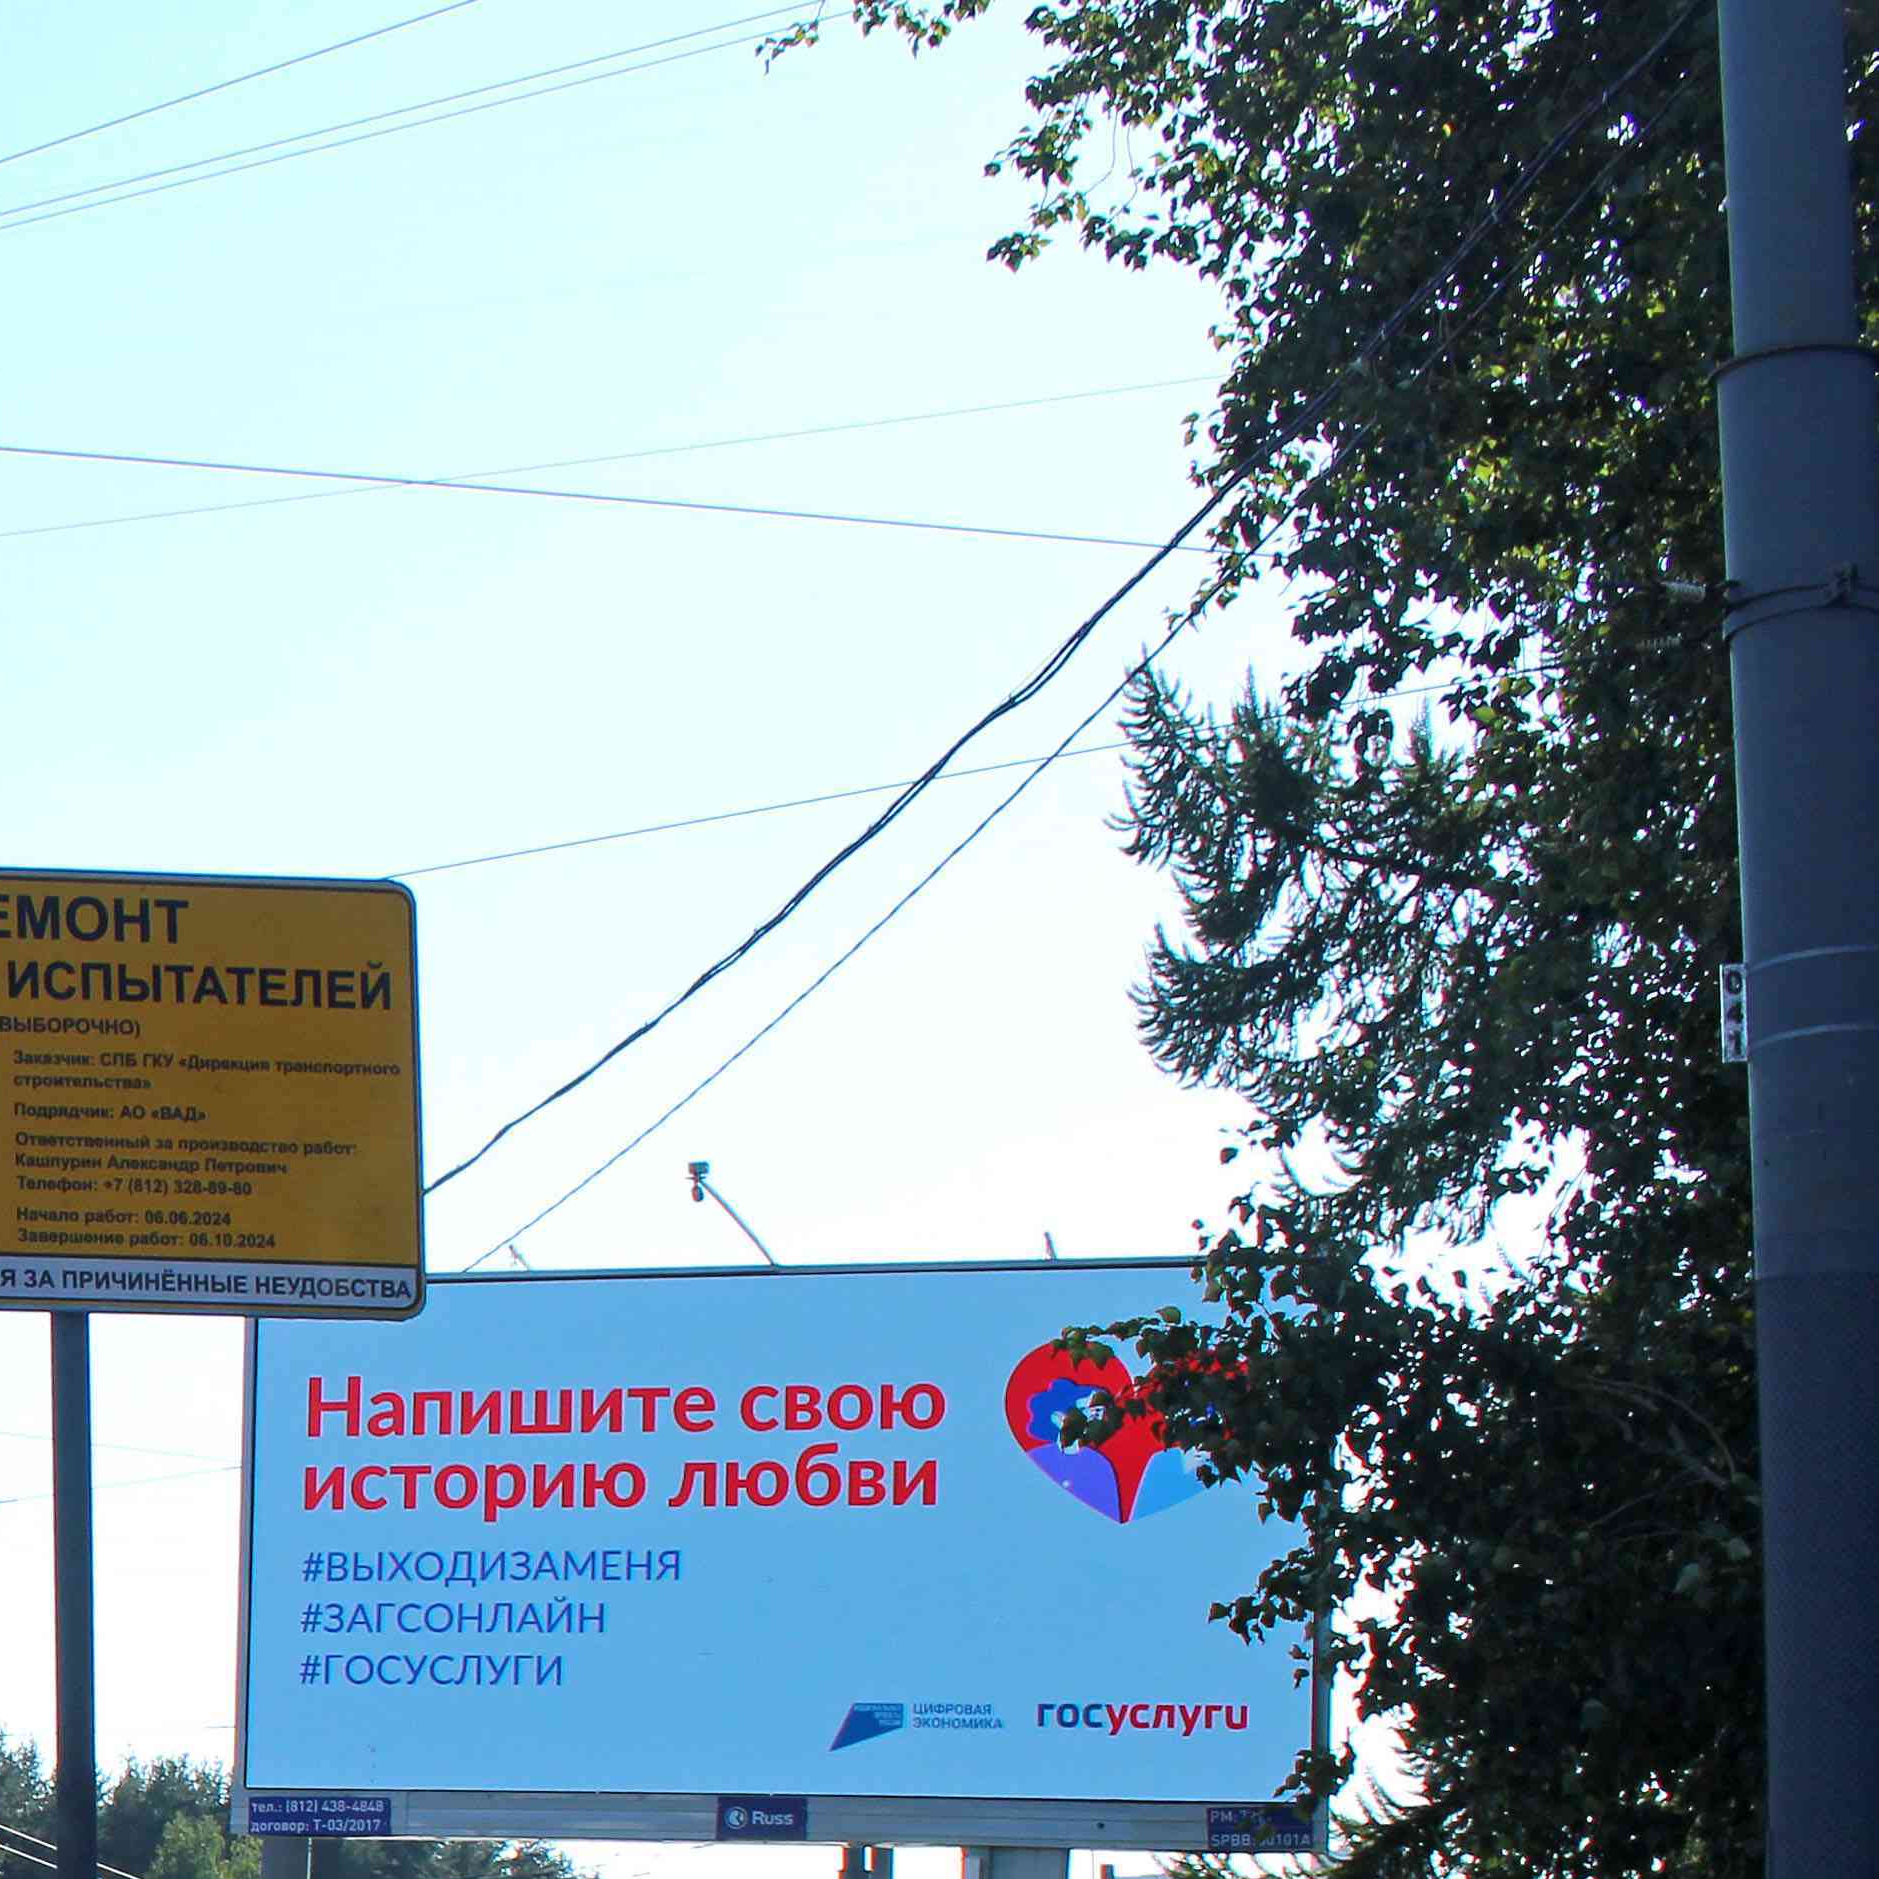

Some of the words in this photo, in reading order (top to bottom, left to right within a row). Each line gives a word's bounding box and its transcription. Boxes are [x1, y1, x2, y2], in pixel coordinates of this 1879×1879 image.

[7, 959, 391, 1010] ИСПЫТАТЕЛЕЙ
[13, 1050, 93, 1066] Заказчик:
[100, 1052, 137, 1067] СПБ
[143, 1052, 175, 1067] ГКУ
[276, 1060, 401, 1076] транспортного
[13, 1074, 152, 1089] строительства»
[14, 1102, 114, 1120] Подрядчик:
[120, 1105, 146, 1119] АО
[151, 1105, 207, 1122] «ВАД»
[15, 1131, 151, 1149] Ответственный
[156, 1138, 173, 1149] за
[178, 1138, 298, 1153] производство
[107, 1154, 199, 1173] Александр
[205, 1158, 288, 1174] Петрович
[17, 1176, 98, 1194] Телефон:
[103, 1178, 123, 1191] +7
[129, 1178, 168, 1195] (812)
[16, 1207, 79, 1222] Начало
[84, 1209, 139, 1225] работ:
[17, 1228, 124, 1245] Завершение
[129, 1231, 184, 1247] работ:
[23, 1268, 55, 1289] ЗА
[62, 1266, 246, 1294] ПРИЧИНЁННЫЕ
[255, 1274, 412, 1299] НЕУДОБСТВА
[307, 1376, 716, 1437] Напишите
[740, 1383, 946, 1432] свою
[304, 1462, 646, 1522] историю
[668, 1443, 937, 1507] любви
[303, 1550, 679, 1587] #ВЫХОДИЗАМЕНЯ
[300, 1595, 605, 1633] #ЗАГСОНЛАЙН
[299, 1654, 562, 1686] #ГОСУСЛУГИ
[913, 1703, 992, 1715] ЦИФРОВАЯ
[912, 1717, 1003, 1729] ЭКОНОМИКА
[1037, 1703, 1248, 1736] госуслуги
[251, 1802, 282, 1812] тел.:
[251, 1821, 310, 1833] договор:
[752, 1810, 794, 1825] Russ
